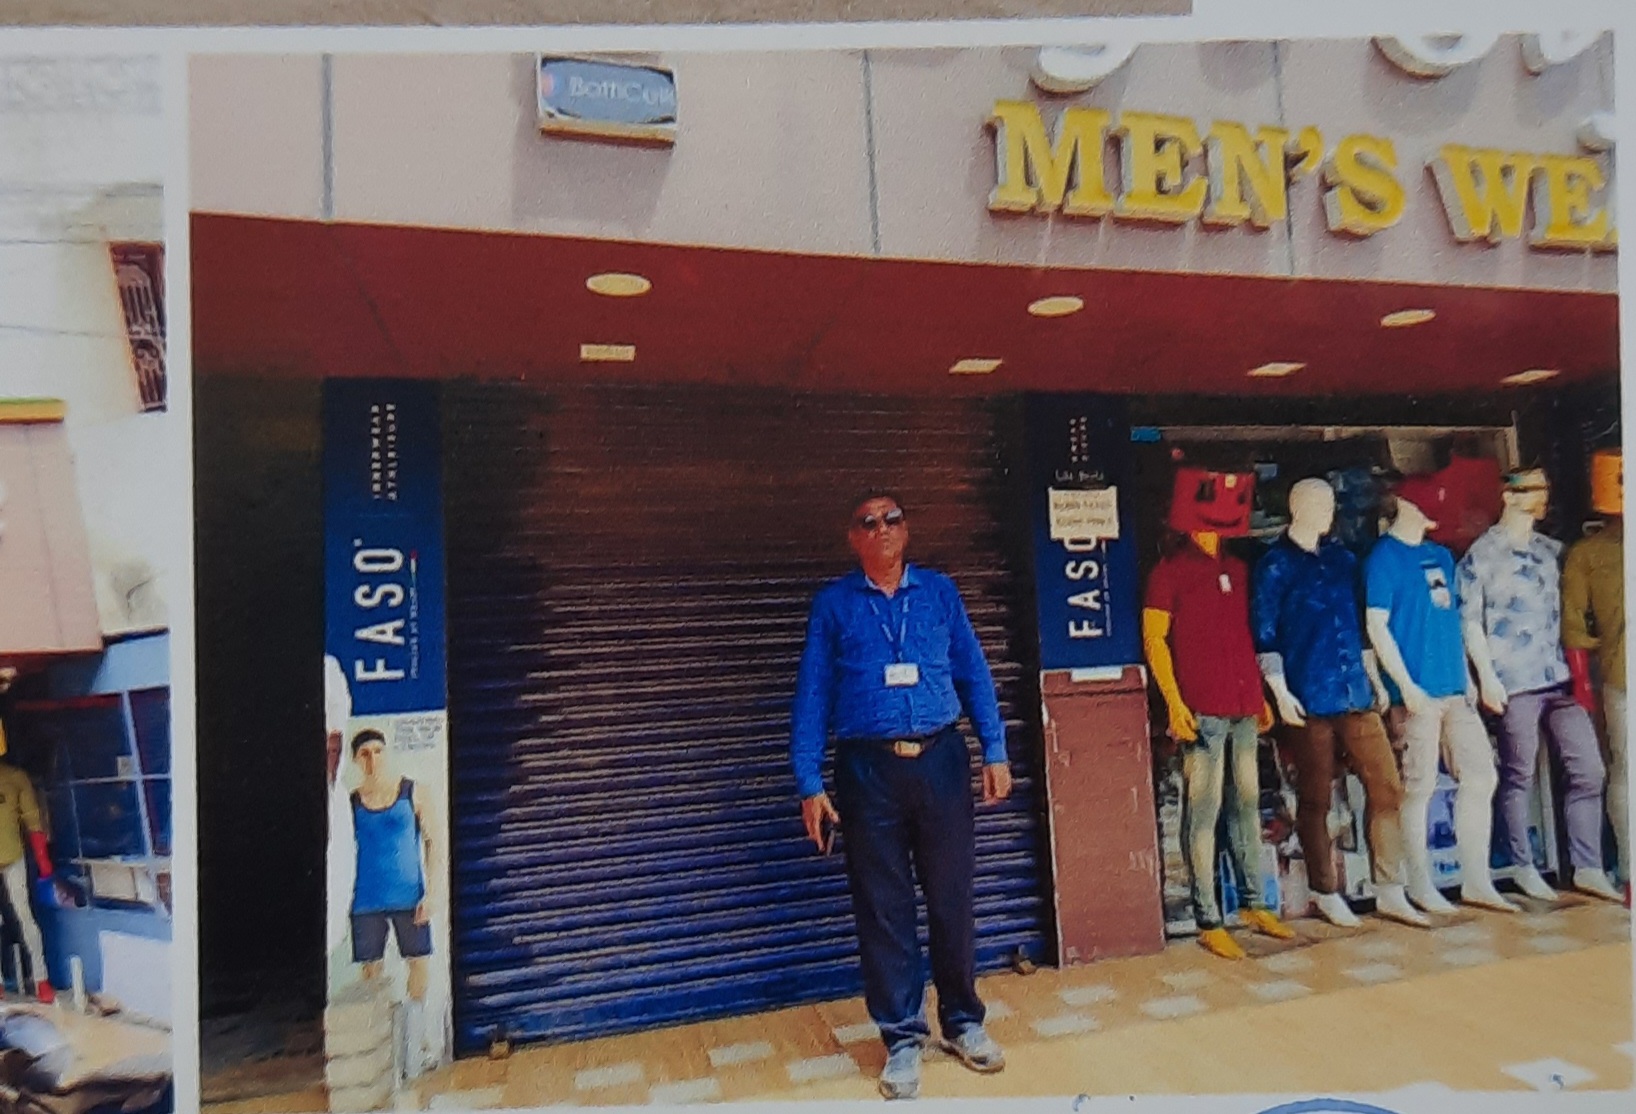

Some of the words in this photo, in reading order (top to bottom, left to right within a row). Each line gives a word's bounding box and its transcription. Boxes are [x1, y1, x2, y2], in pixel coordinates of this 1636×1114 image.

[986, 100, 1406, 234] MEN'S
[1430, 143, 1618, 244] WE
[354, 547, 405, 682] FASO
